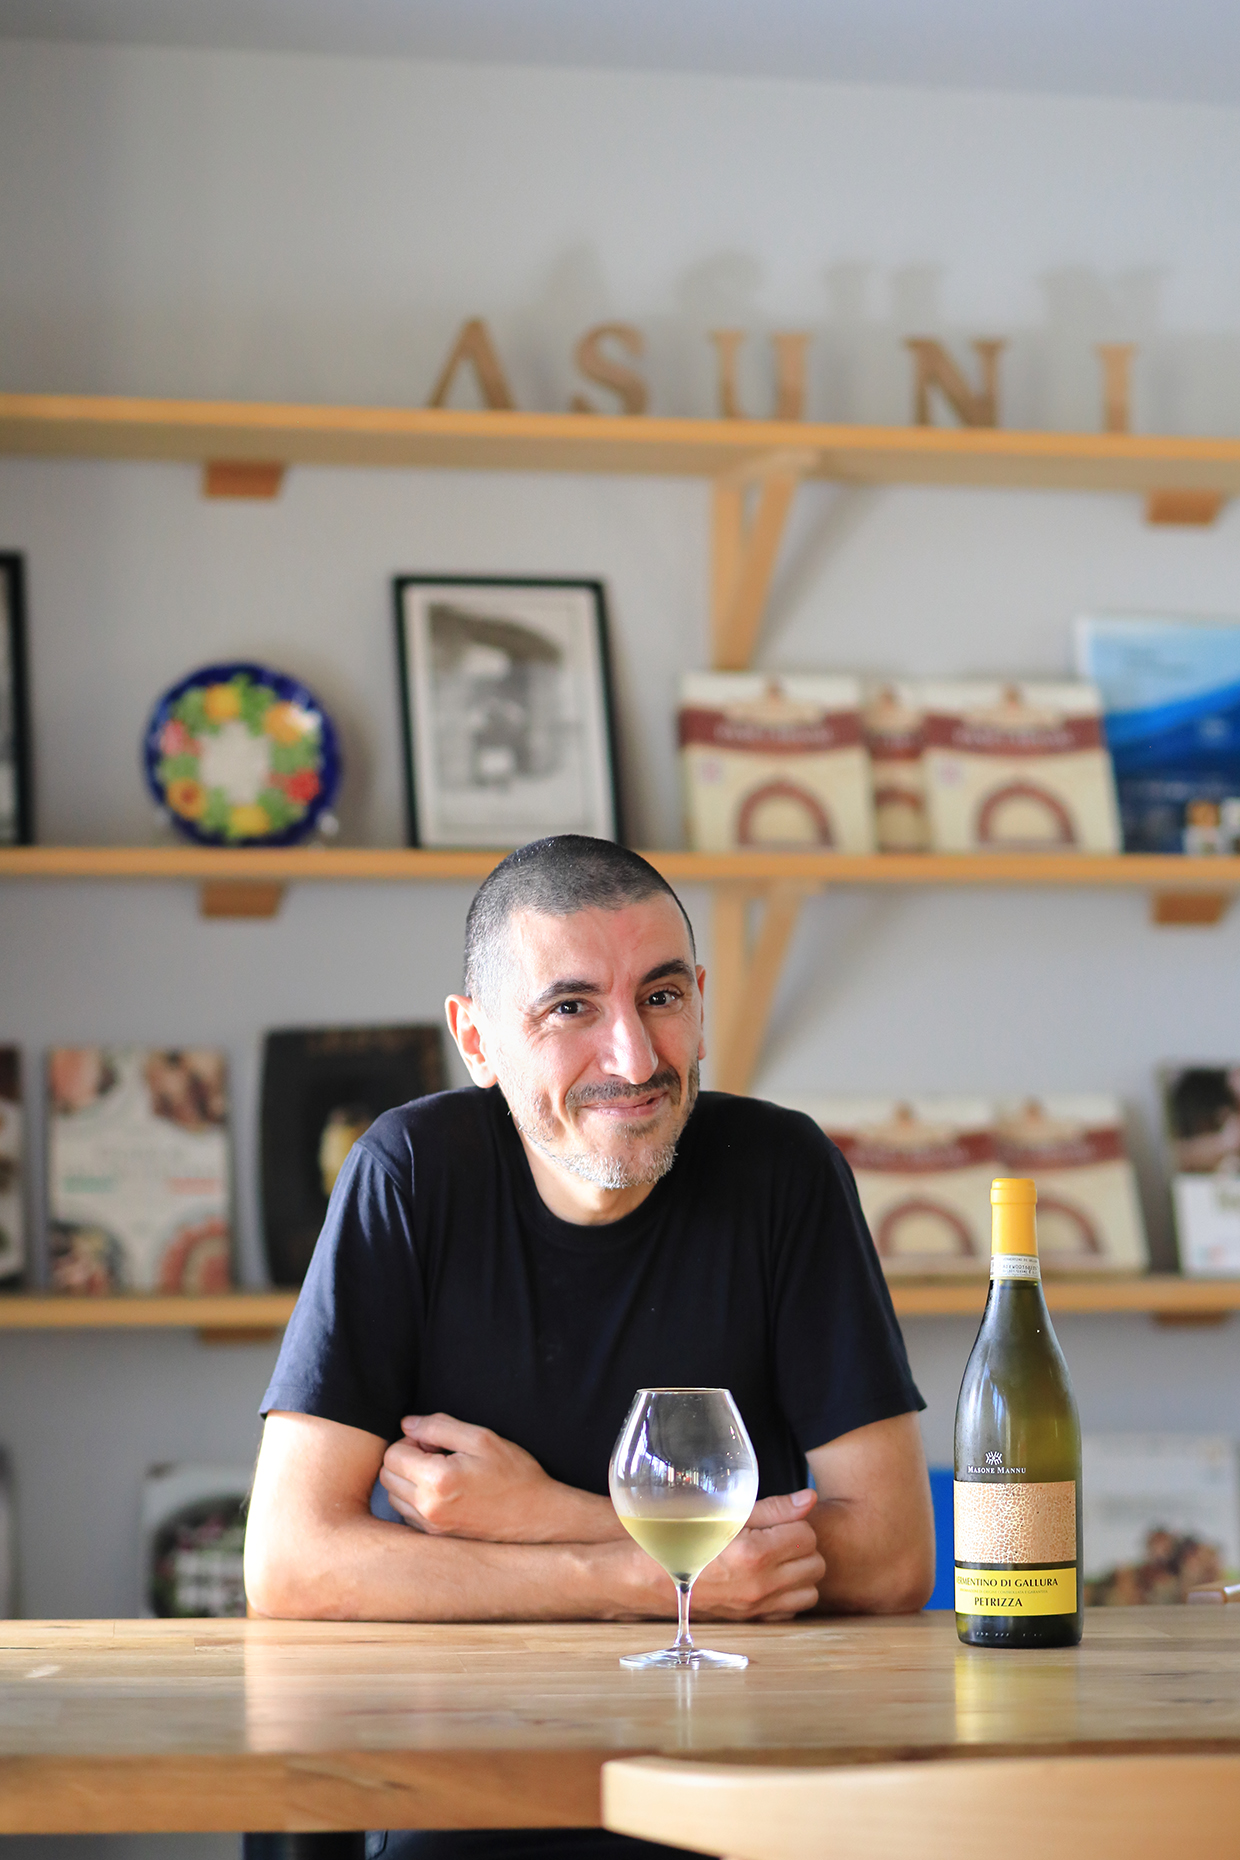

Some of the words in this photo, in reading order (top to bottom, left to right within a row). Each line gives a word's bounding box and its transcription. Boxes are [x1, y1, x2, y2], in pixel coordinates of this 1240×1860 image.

[428, 314, 1138, 435] ASUNI
[967, 1465, 995, 1474] MASONE
[997, 1466, 1027, 1474] MANNU
[956, 1576, 998, 1587] ERMENTINO
[1000, 1579, 1012, 1587] DI
[1014, 1578, 1059, 1588] GALLURA
[974, 1596, 1023, 1607] PETRIZZA
